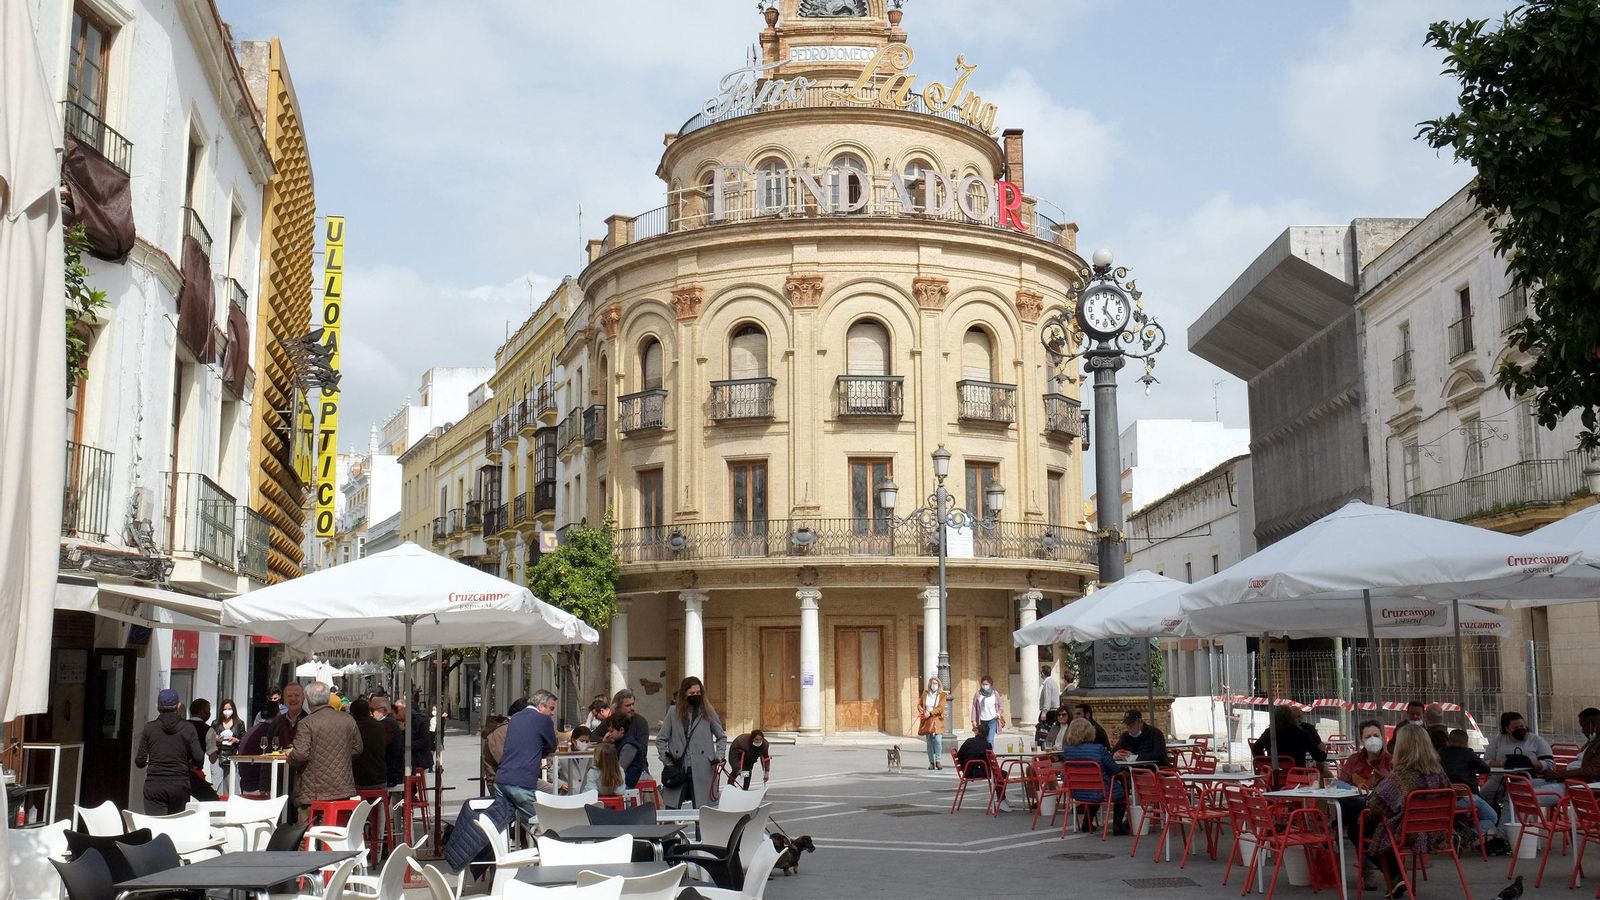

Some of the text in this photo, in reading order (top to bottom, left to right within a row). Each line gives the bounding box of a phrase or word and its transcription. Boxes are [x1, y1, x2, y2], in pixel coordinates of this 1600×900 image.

[791, 48, 828, 60] PEDRO
[701, 43, 999, 135] Fino La Ina
[711, 164, 1030, 232] FUNDADOR
[324, 221, 344, 353] ULLOA
[1507, 555, 1569, 567] Cruzcampo
[1382, 607, 1436, 619] Cruzcampo
[1460, 621, 1501, 631] ruzcampo
[1103, 651, 1141, 661] PEDRO
